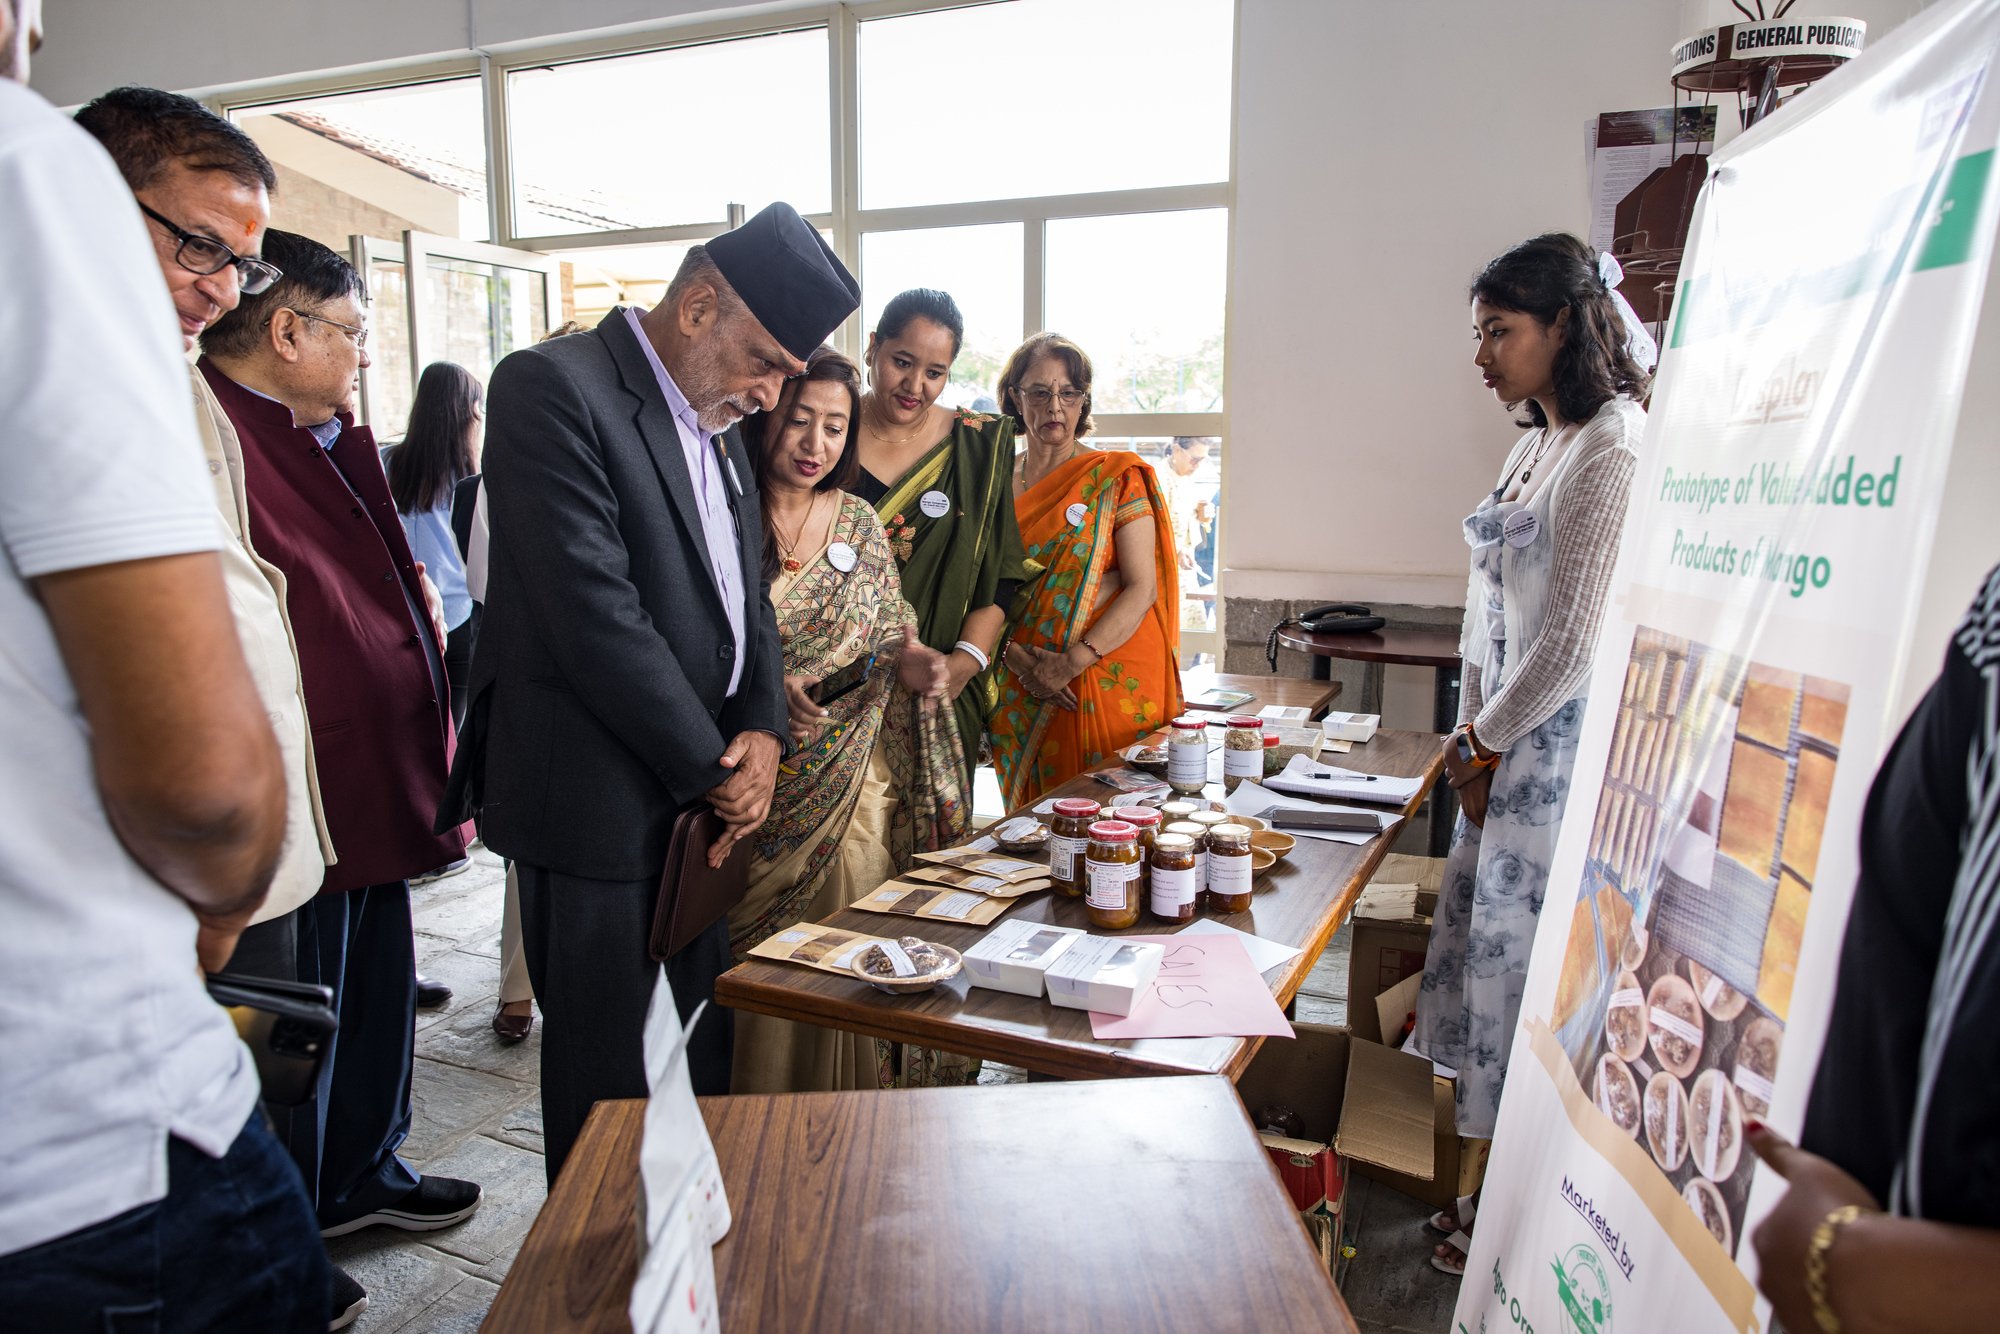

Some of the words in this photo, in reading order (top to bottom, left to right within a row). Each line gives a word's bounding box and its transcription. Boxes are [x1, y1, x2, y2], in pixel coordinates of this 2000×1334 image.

[1736, 26, 1803, 50] GENERAL
[1660, 466, 1730, 514] Prototype
[1734, 463, 1757, 505] of
[1670, 528, 1737, 575] Products
[1741, 536, 1765, 577] of
[1561, 1174, 1621, 1252] Marketed
[1620, 1241, 1635, 1281] by
[1493, 1256, 1507, 1305] Agro
